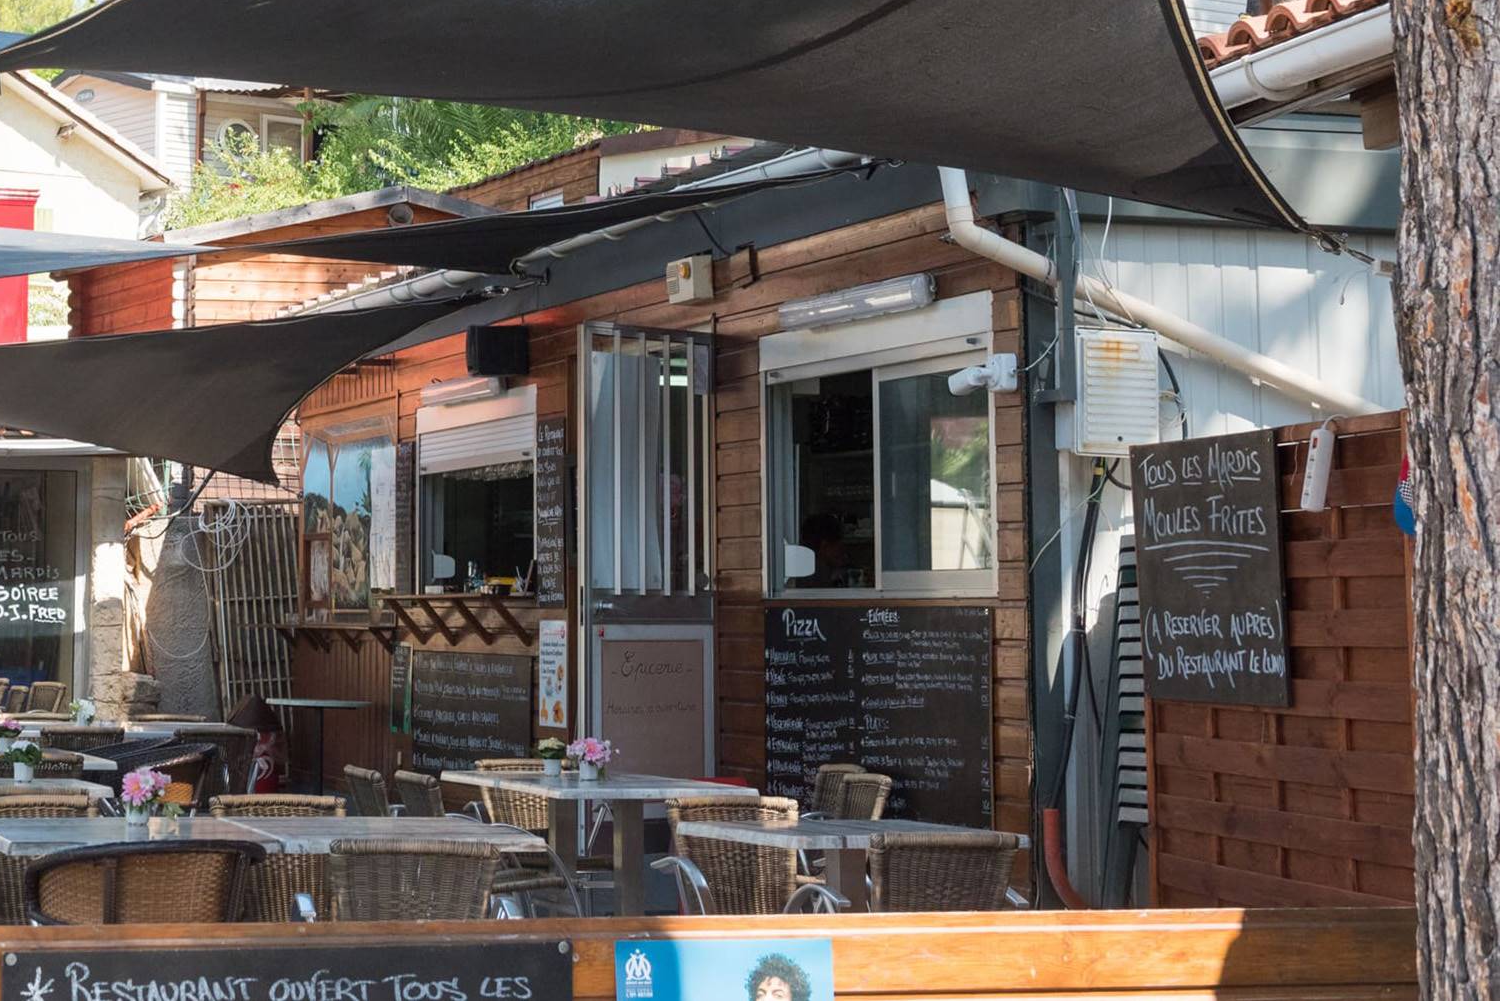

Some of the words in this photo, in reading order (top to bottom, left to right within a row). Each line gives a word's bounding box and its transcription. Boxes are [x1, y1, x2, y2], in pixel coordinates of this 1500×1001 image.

[1138, 454, 1177, 486] TOUS
[1182, 455, 1202, 479] LES
[1143, 497, 1201, 543] MOULES
[1206, 495, 1267, 536] FRITES
[781, 608, 828, 643] PIZZA
[1157, 652, 1174, 680] DU
[1176, 646, 1246, 689] RESTAURANT
[1249, 649, 1261, 674] LE
[65, 961, 258, 1001] RESTAURANT
[269, 969, 377, 1001] OUVERT
[381, 973, 468, 1001] TOUS
[479, 976, 533, 999] LES
